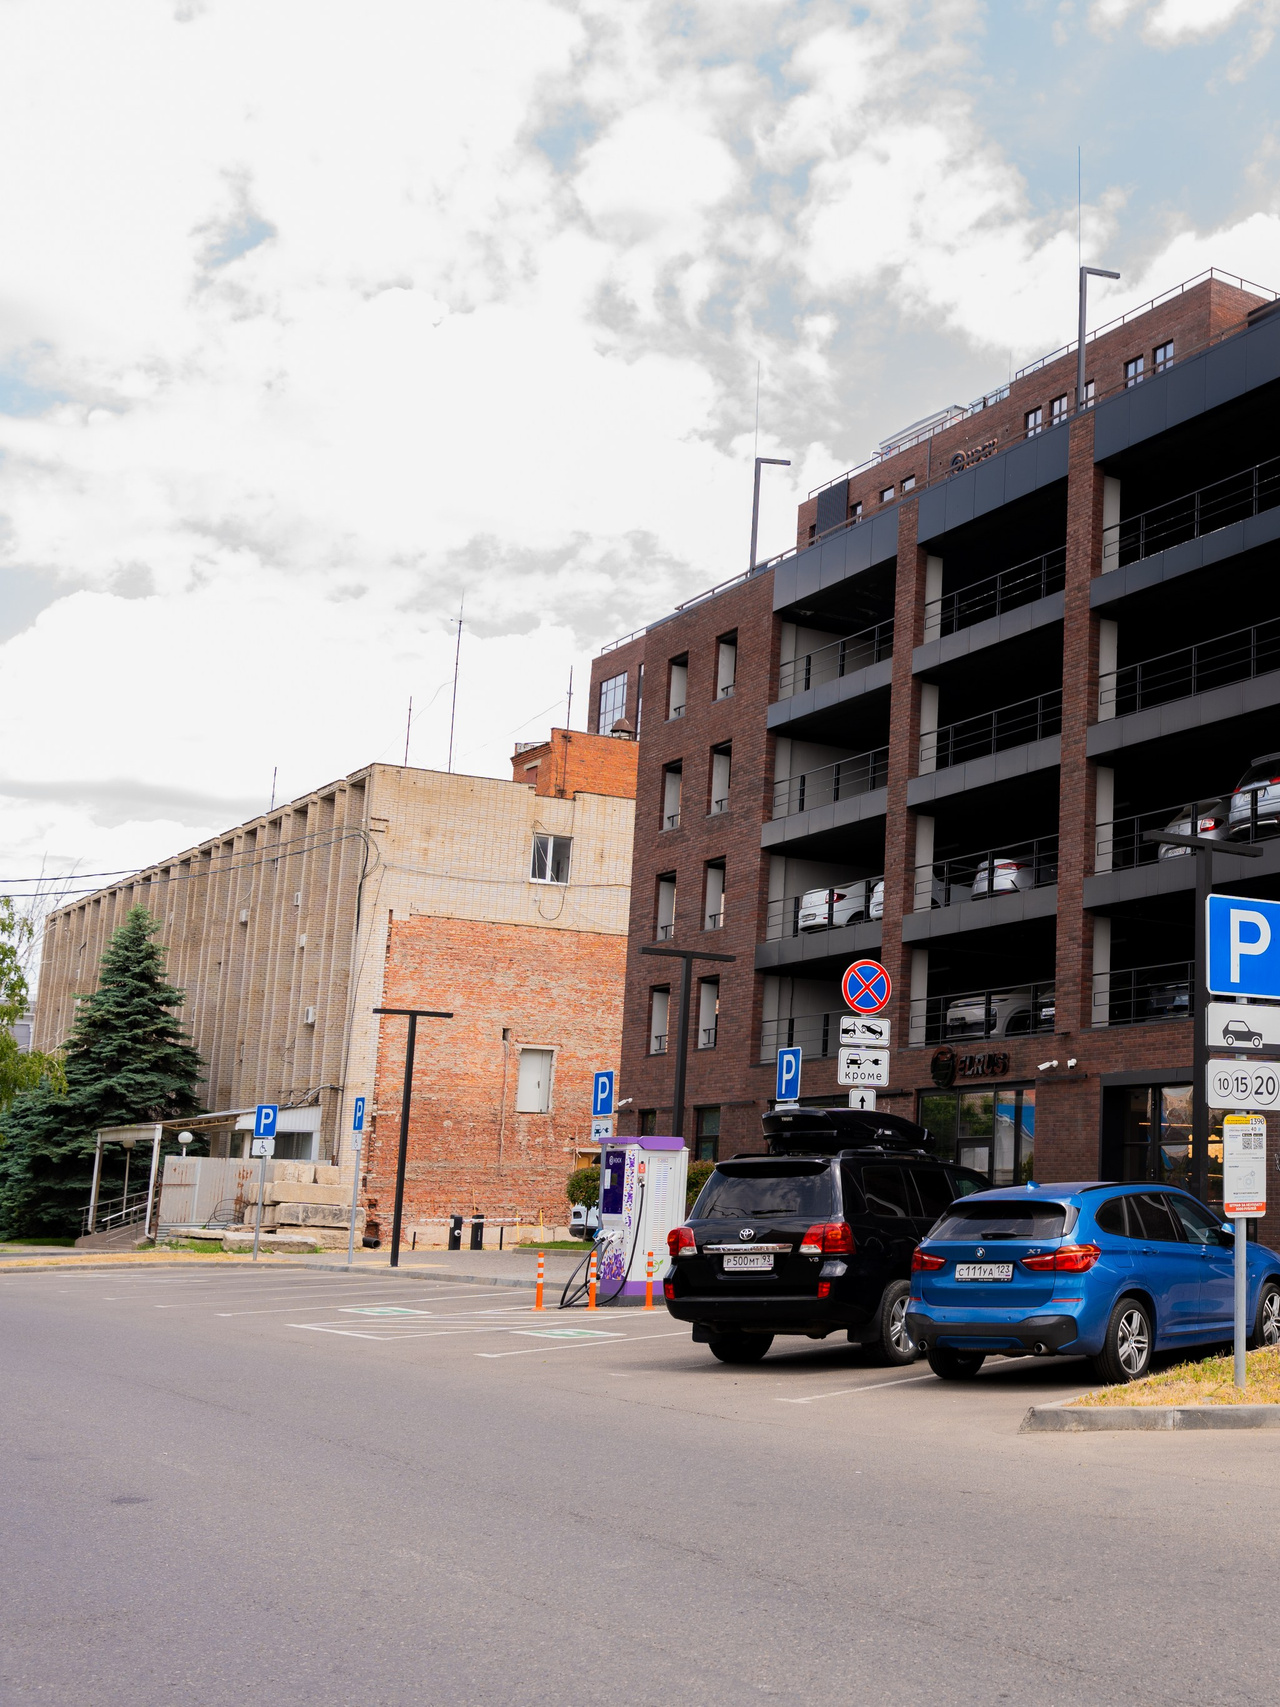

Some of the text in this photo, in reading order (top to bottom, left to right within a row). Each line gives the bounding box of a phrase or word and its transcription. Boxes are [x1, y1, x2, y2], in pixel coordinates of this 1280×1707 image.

[1230, 908, 1271, 983] P
[781, 1054, 796, 1095] P
[845, 1071, 882, 1082] кроме
[958, 1051, 1010, 1077] ELRUS
[597, 1076, 610, 1111] P
[1217, 1076, 1276, 1095] 10 15 20
[260, 1108, 273, 1133] P
[355, 1100, 363, 1127] P
[958, 1265, 1010, 1276] С111УА 123
